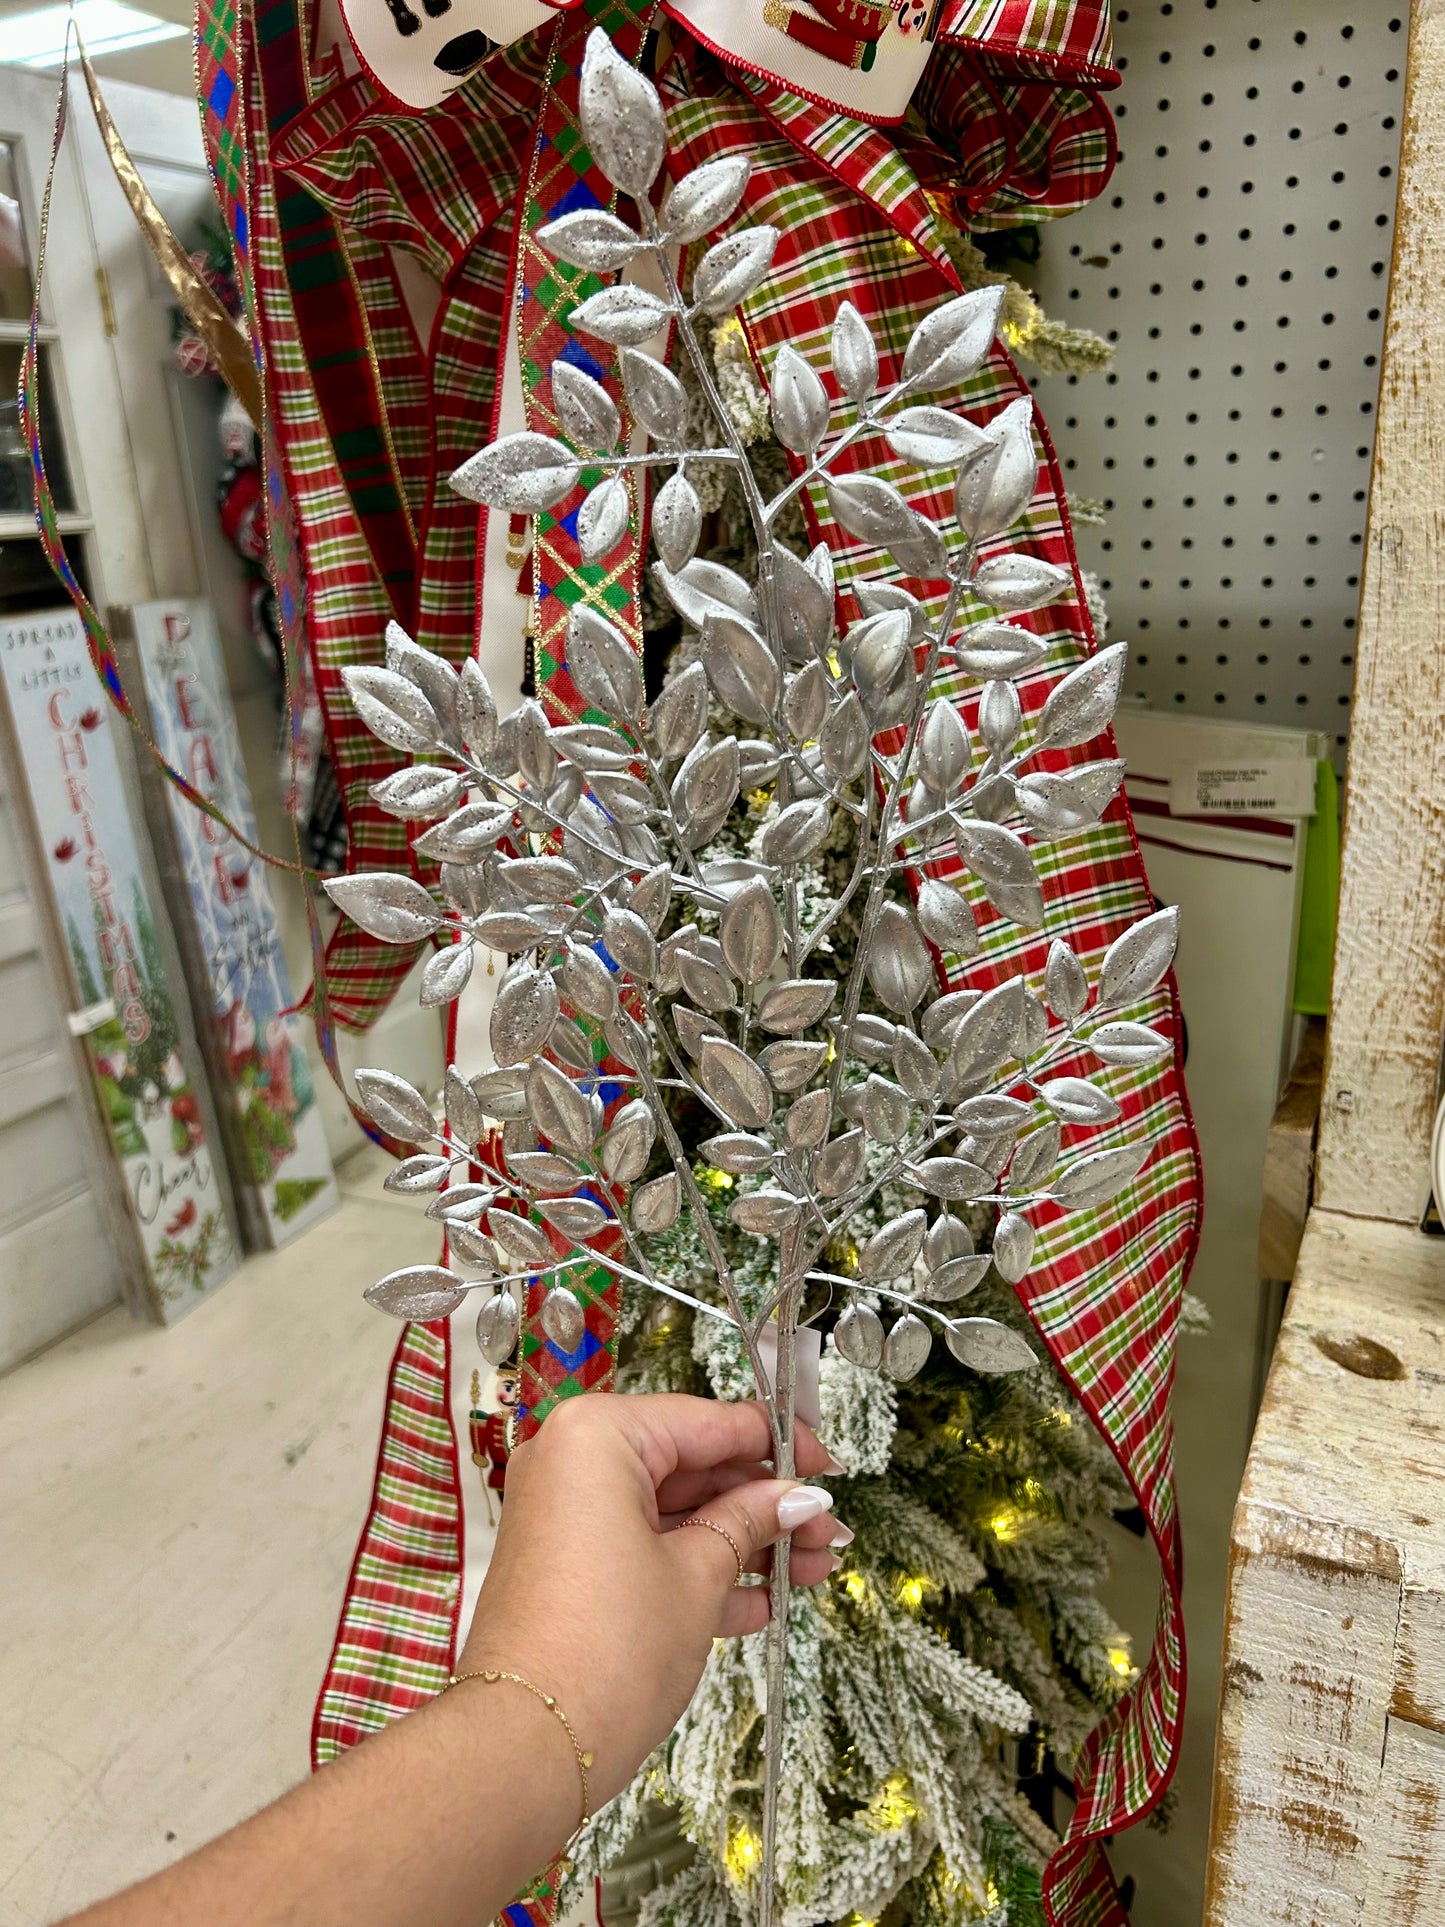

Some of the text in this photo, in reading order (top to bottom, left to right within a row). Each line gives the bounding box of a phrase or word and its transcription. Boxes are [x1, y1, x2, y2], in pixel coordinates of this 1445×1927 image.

[21, 662, 83, 689] LITTLE
[48, 687, 150, 1043] CHRISTMAS
[135, 1157, 210, 1226] Cheer
